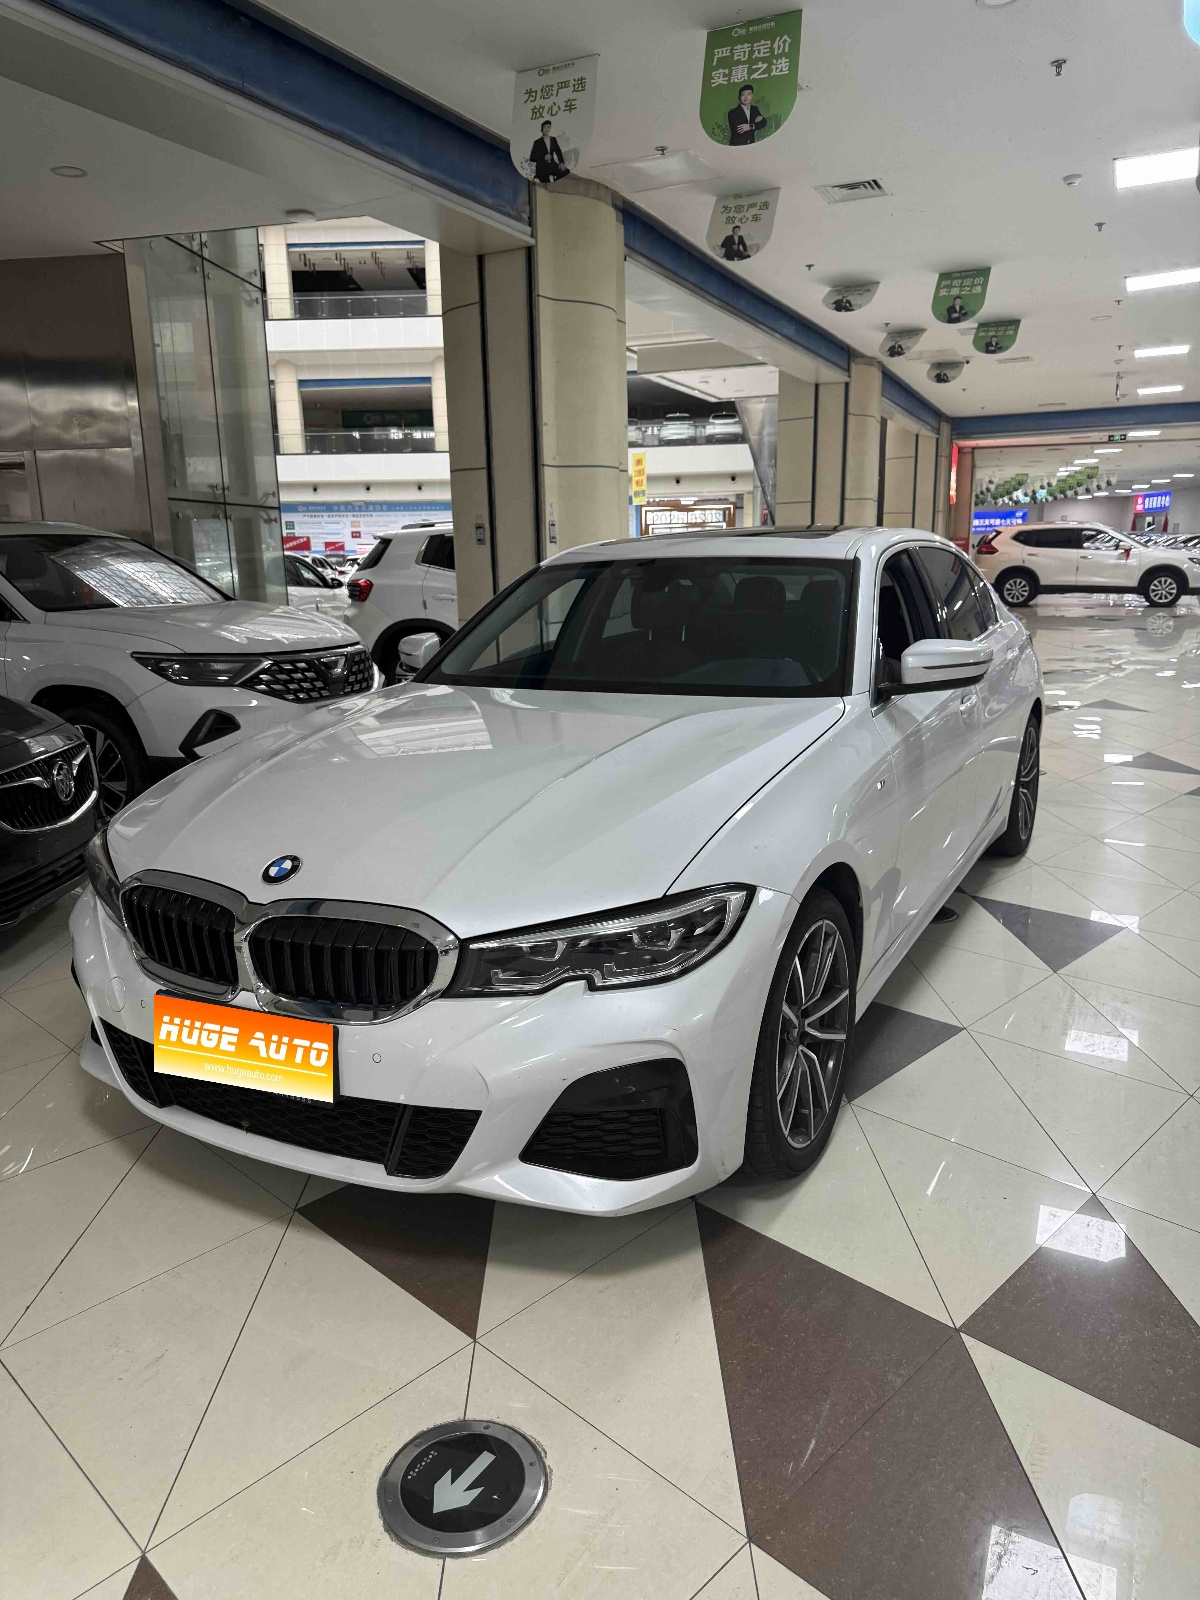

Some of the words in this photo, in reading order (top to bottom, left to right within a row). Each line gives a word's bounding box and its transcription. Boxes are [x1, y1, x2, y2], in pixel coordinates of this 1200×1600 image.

[713, 35, 791, 66] 严苛定价
[711, 57, 790, 87] 实惠之选
[523, 76, 587, 104] 为您严选
[530, 98, 578, 121] 放心车
[721, 200, 770, 214] 为您严选
[725, 213, 762, 224] 放心车
